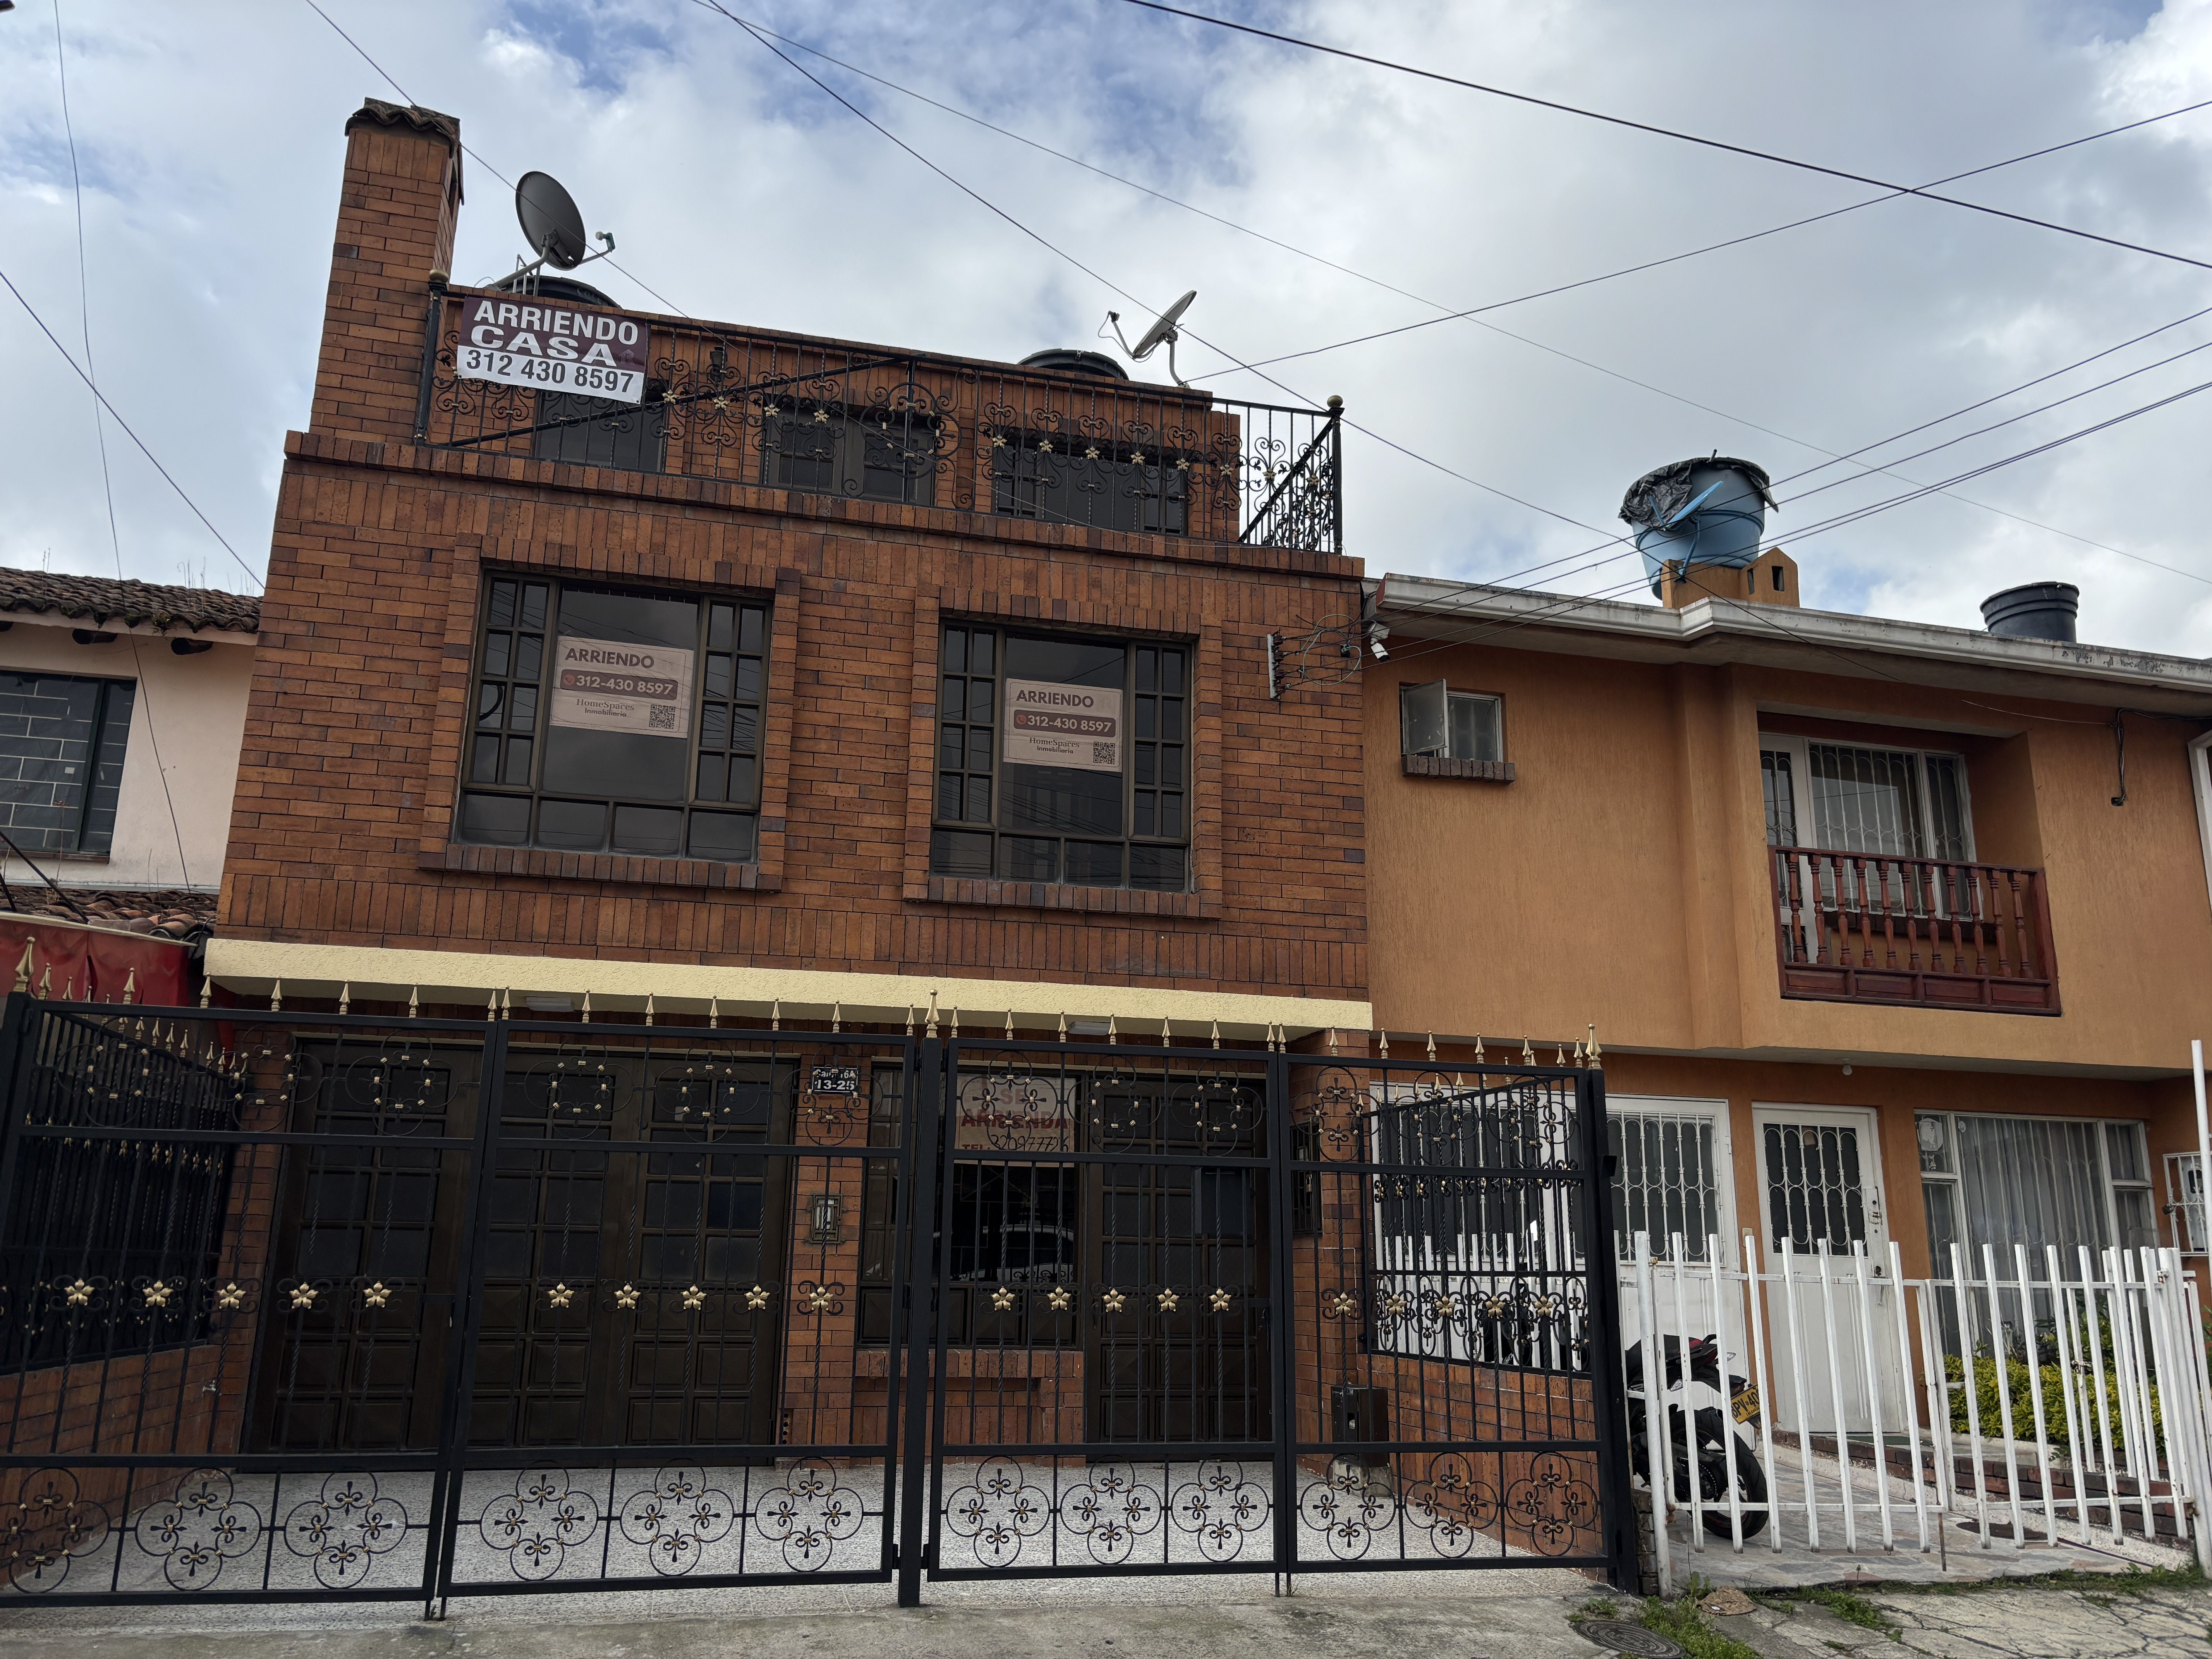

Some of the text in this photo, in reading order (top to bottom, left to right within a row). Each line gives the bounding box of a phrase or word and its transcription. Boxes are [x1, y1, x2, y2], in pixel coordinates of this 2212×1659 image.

[474, 301, 639, 345] ARRIENDO
[471, 325, 617, 367] CASA
[467, 350, 634, 393] 312 430 8597
[565, 648, 654, 668] ARRIENDO
[576, 675, 673, 695] 312-430 8597
[577, 699, 634, 711] HomeSpaces
[1016, 690, 1094, 708] ARRIENDO
[585, 708, 627, 717] Inmobiliaria
[1028, 715, 1112, 732] 312-430 8597
[1030, 737, 1079, 749] HomeSpaces
[1037, 745, 1073, 754] Inmobiliaria
[815, 1079, 855, 1090] 13-25
[1000, 1088, 1027, 1104] SE
[1747, 1389, 1759, 1407] 40
